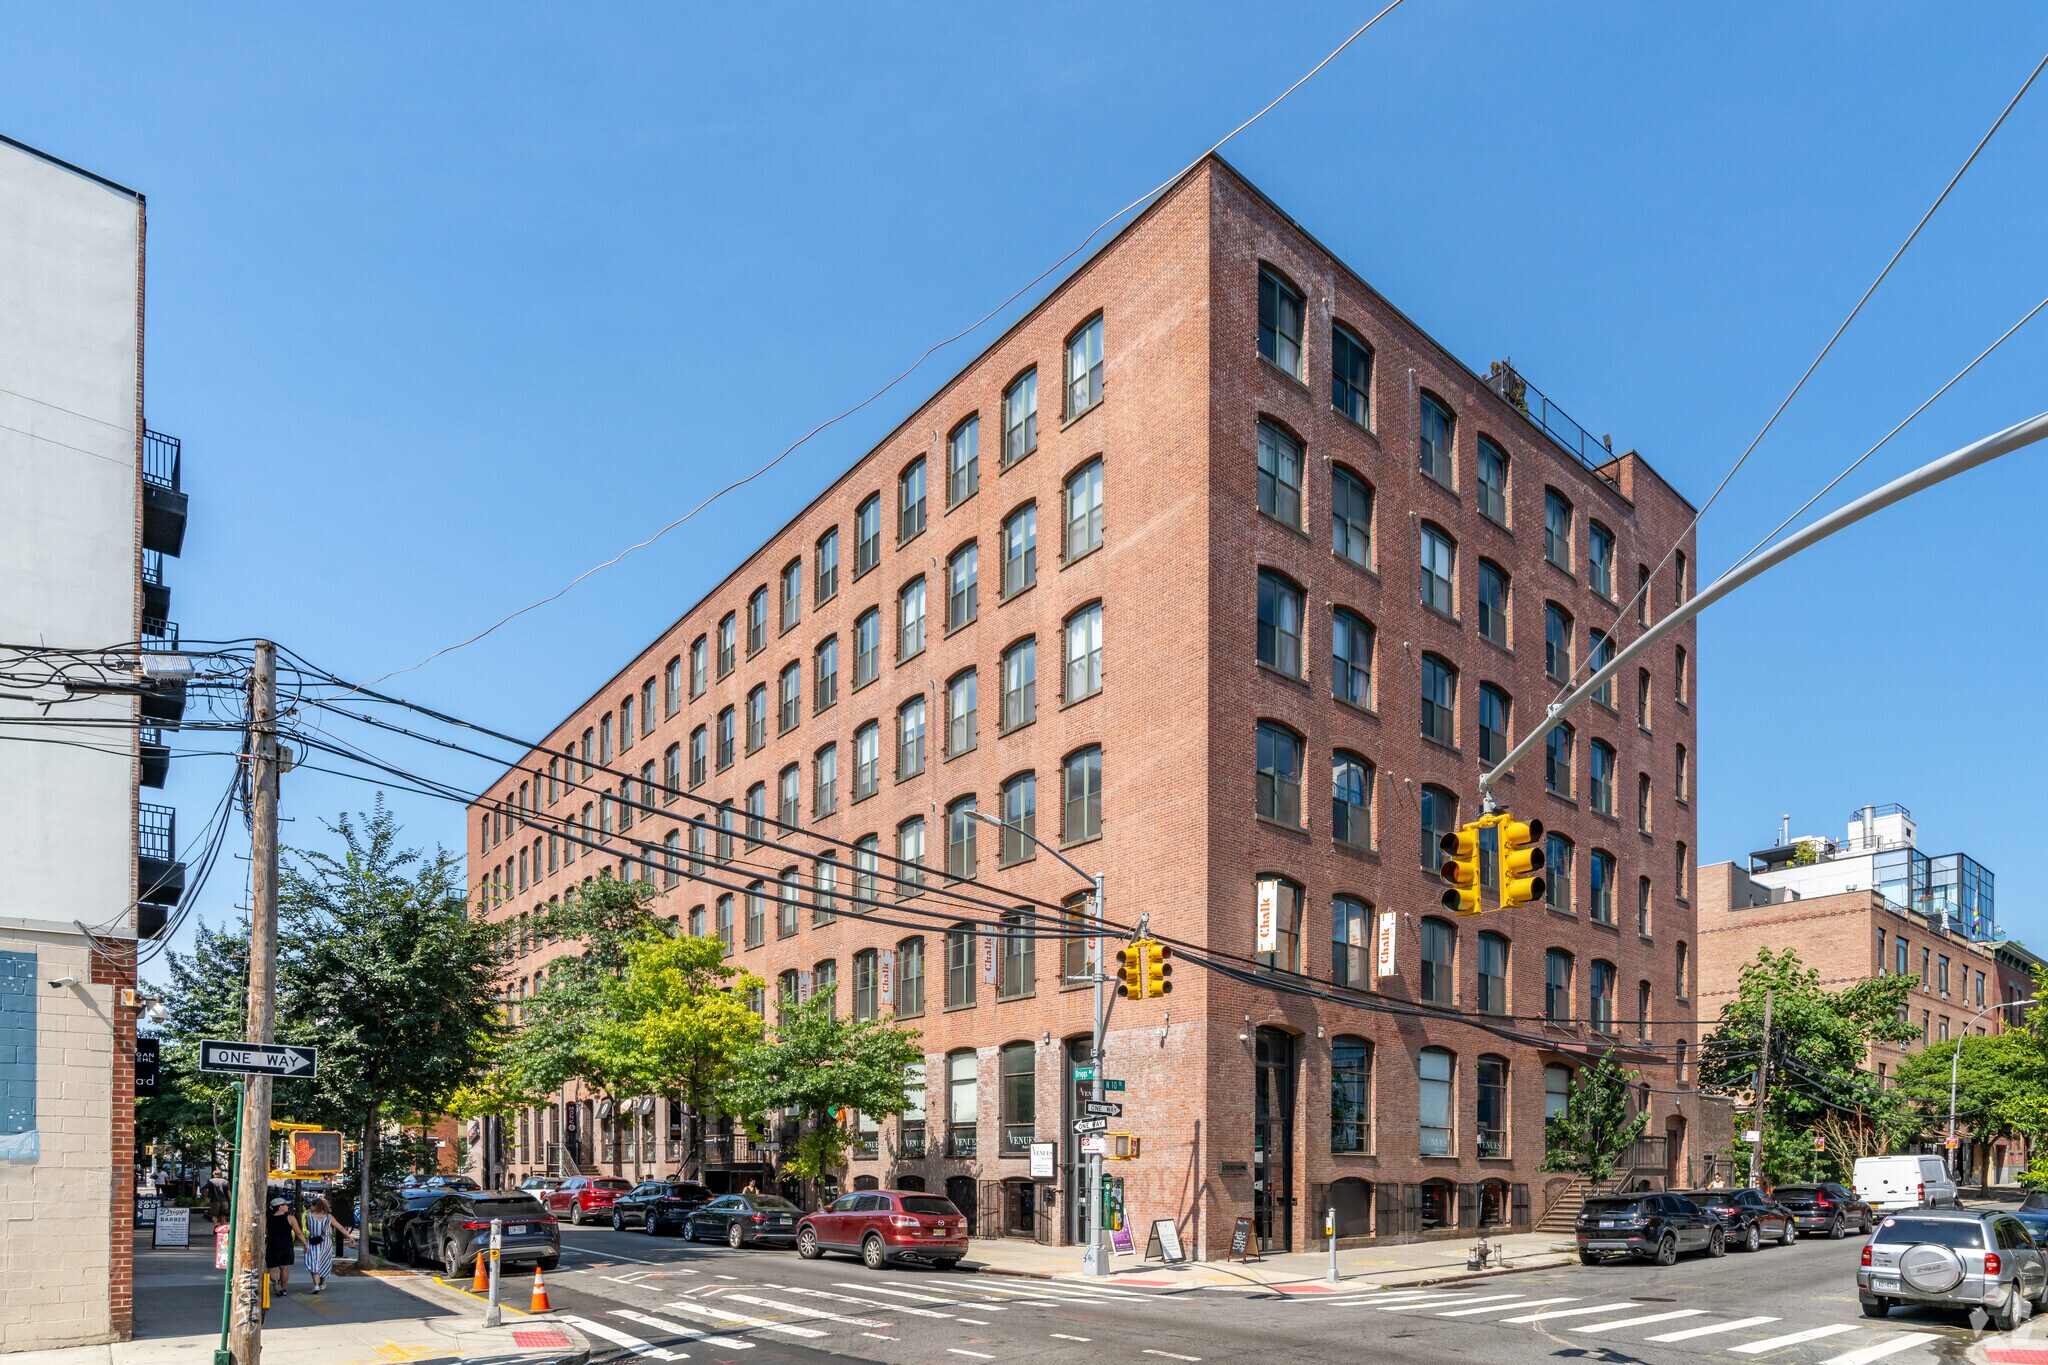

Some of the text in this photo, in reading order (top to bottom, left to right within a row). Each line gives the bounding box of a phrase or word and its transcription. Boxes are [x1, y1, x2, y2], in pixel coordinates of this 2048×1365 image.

[1260, 897, 1270, 938] Chalk
[1380, 927, 1390, 964] Chalk
[984, 937, 992, 972] Chalk
[218, 1050, 300, 1068] ONE WAY
[1075, 1069, 1088, 1080] Driggs
[1111, 1082, 1118, 1090] 10
[953, 1132, 977, 1147] AVENUE
[159, 1207, 187, 1217] Driggs
